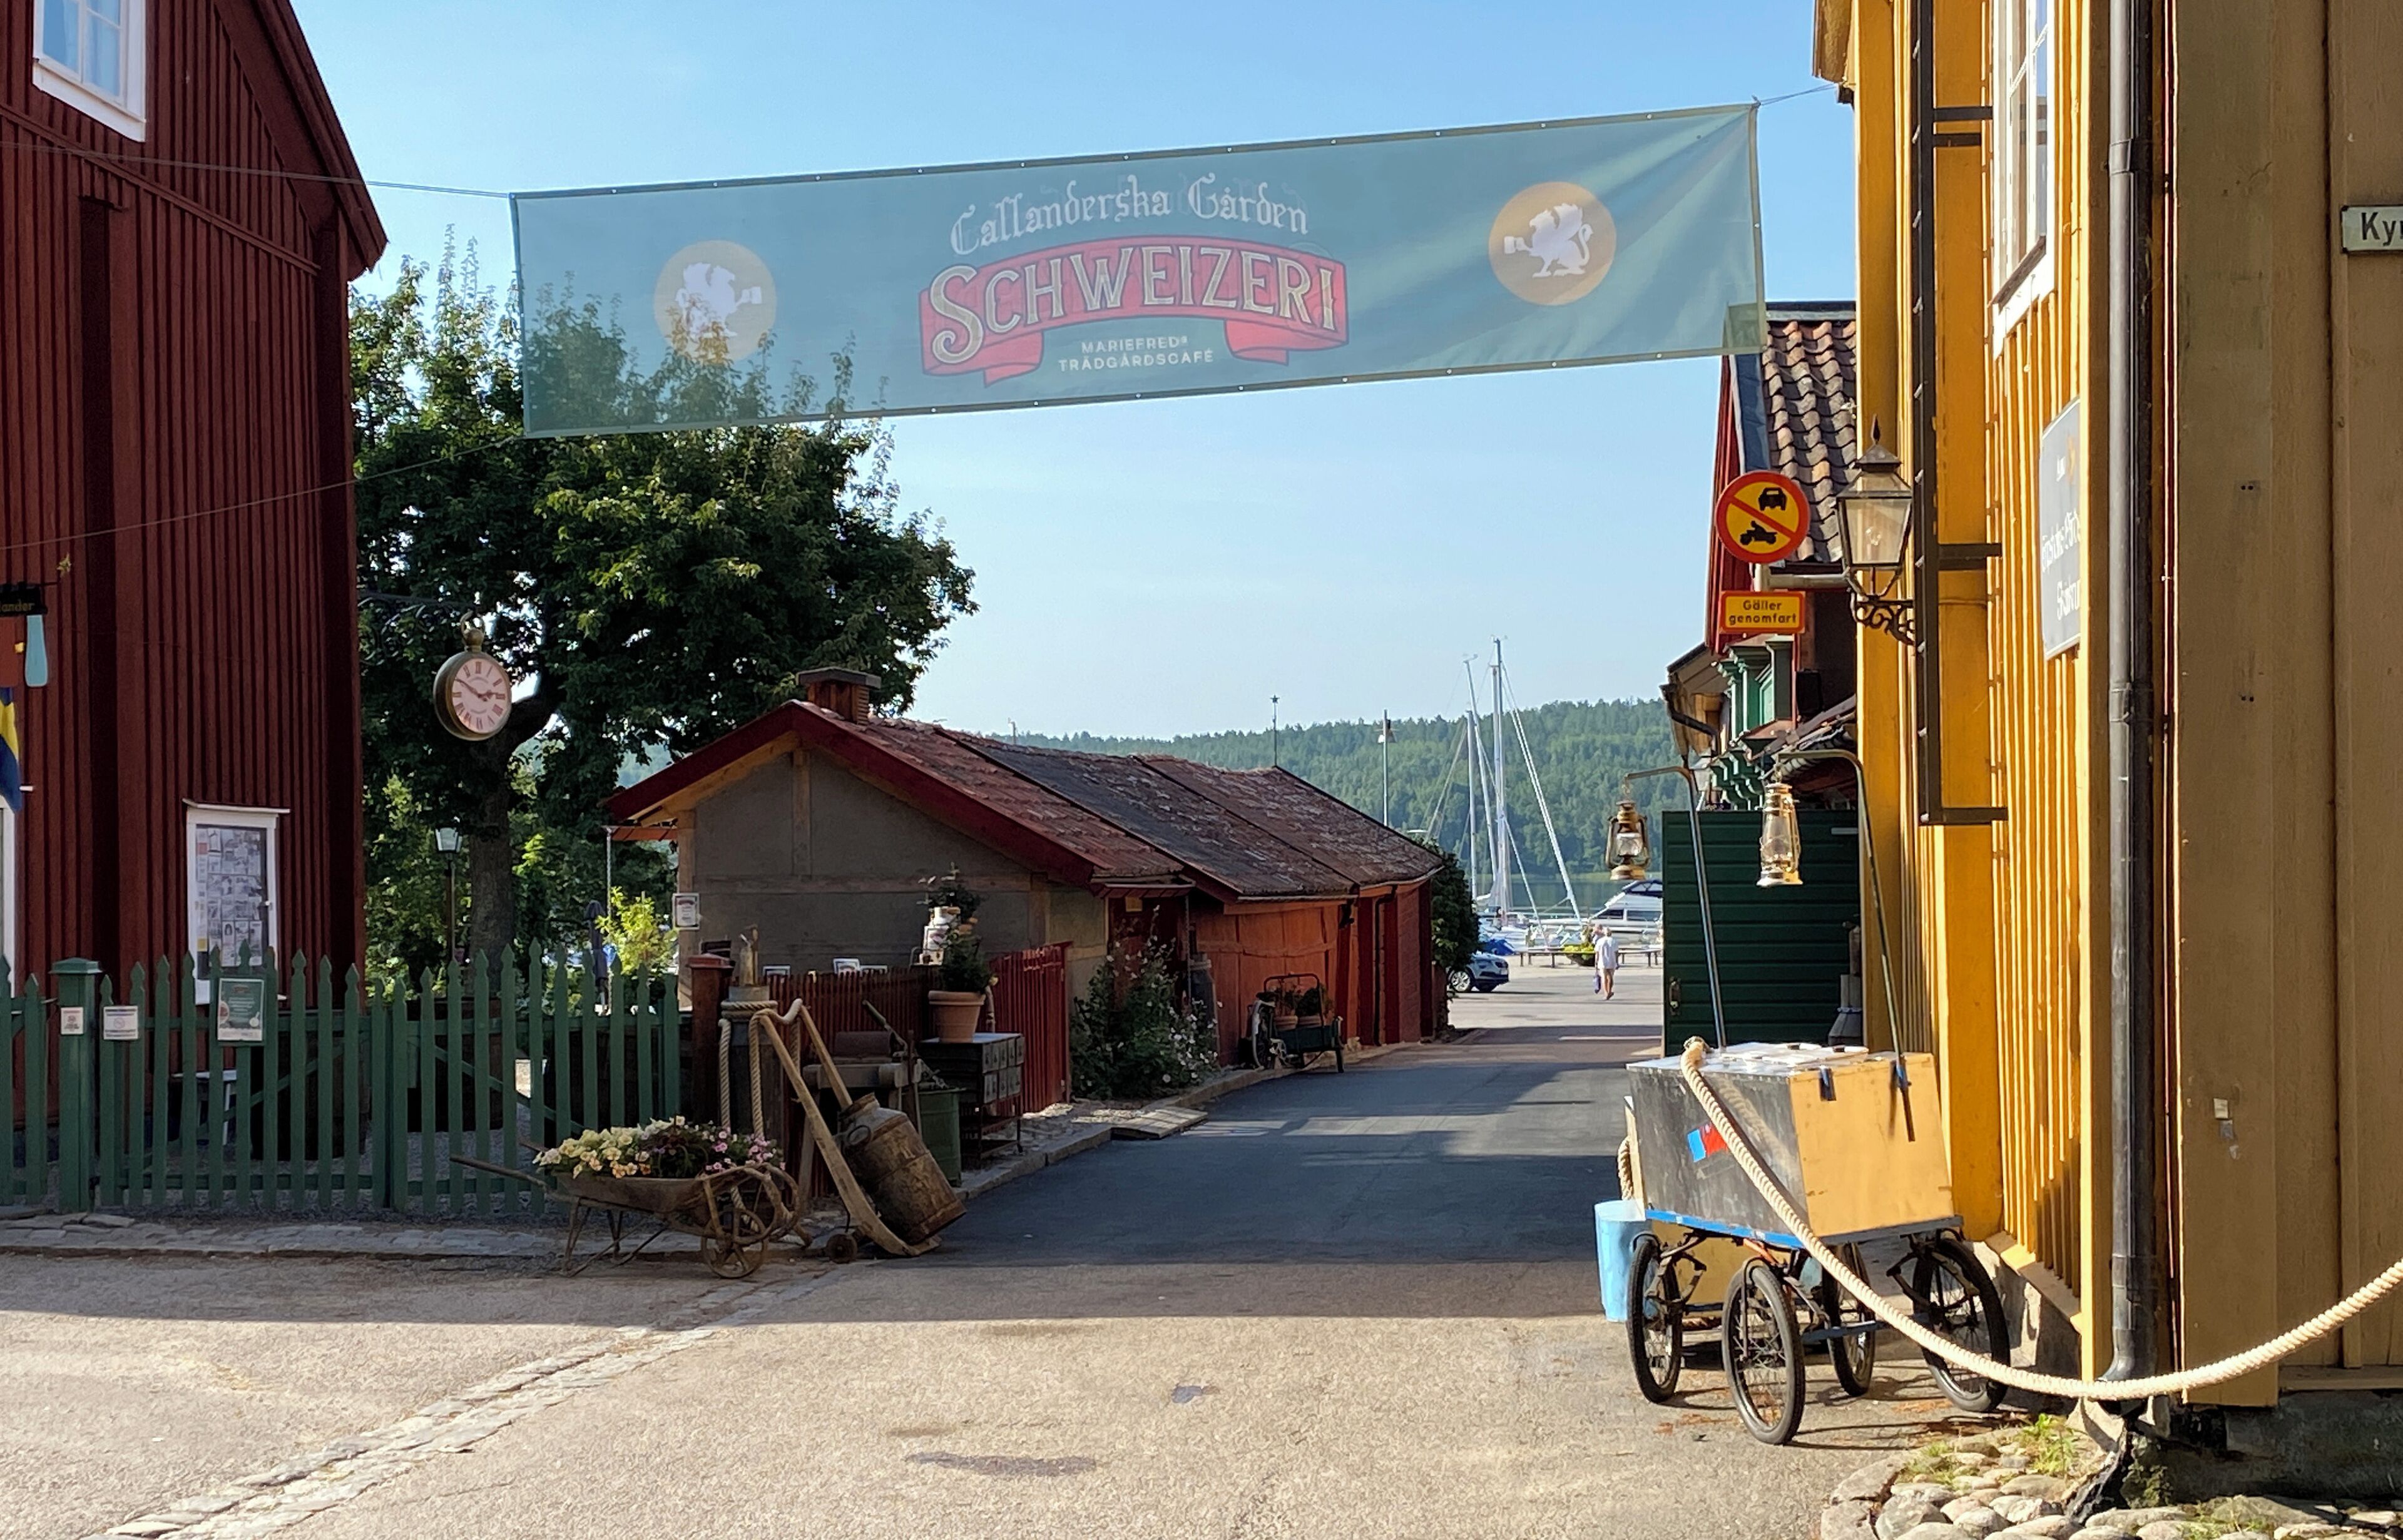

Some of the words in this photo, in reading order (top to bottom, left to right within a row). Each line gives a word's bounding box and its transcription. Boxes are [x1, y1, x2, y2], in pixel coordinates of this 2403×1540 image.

[1188, 172, 1309, 235] Gården
[929, 245, 1337, 364] SCHWEIZERI
[1058, 348, 1214, 372] TRÄDGÅRDSCAFÉ
[1742, 599, 1782, 611] Gäller
[1728, 613, 1797, 625] genomfart
